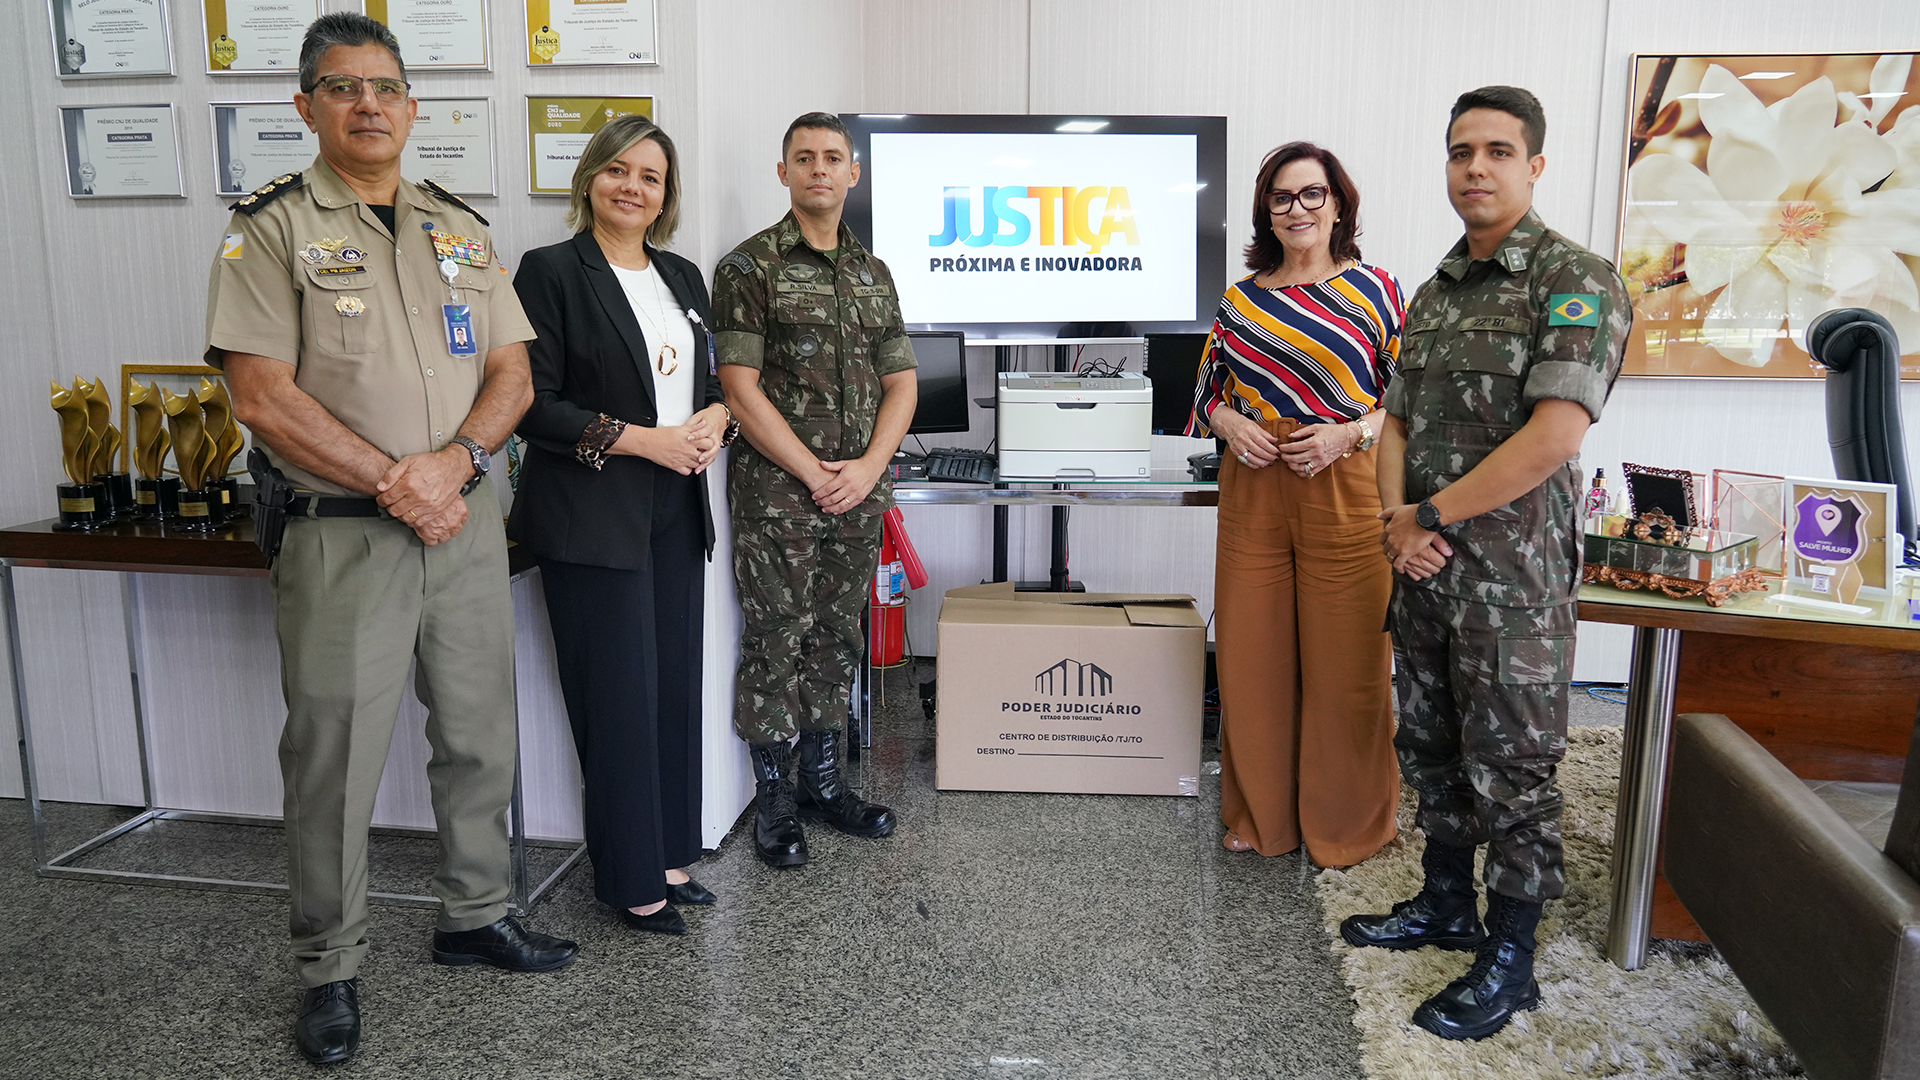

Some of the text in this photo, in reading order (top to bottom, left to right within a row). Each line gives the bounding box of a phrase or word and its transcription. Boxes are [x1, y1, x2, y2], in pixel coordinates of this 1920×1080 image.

[535, 35, 558, 46] Justiça
[215, 43, 235, 53] Justiça
[928, 185, 1141, 255] JUSTIÇA
[930, 254, 1142, 272] PRÓXIMA E INOVADORA
[790, 283, 817, 291] R.SILVA
[1799, 542, 1852, 554] SALVE MULHER
[1002, 702, 1142, 715] PODER JUDICIÁRIO
[1052, 734, 1114, 743] DISTRIBUIÇÃO
